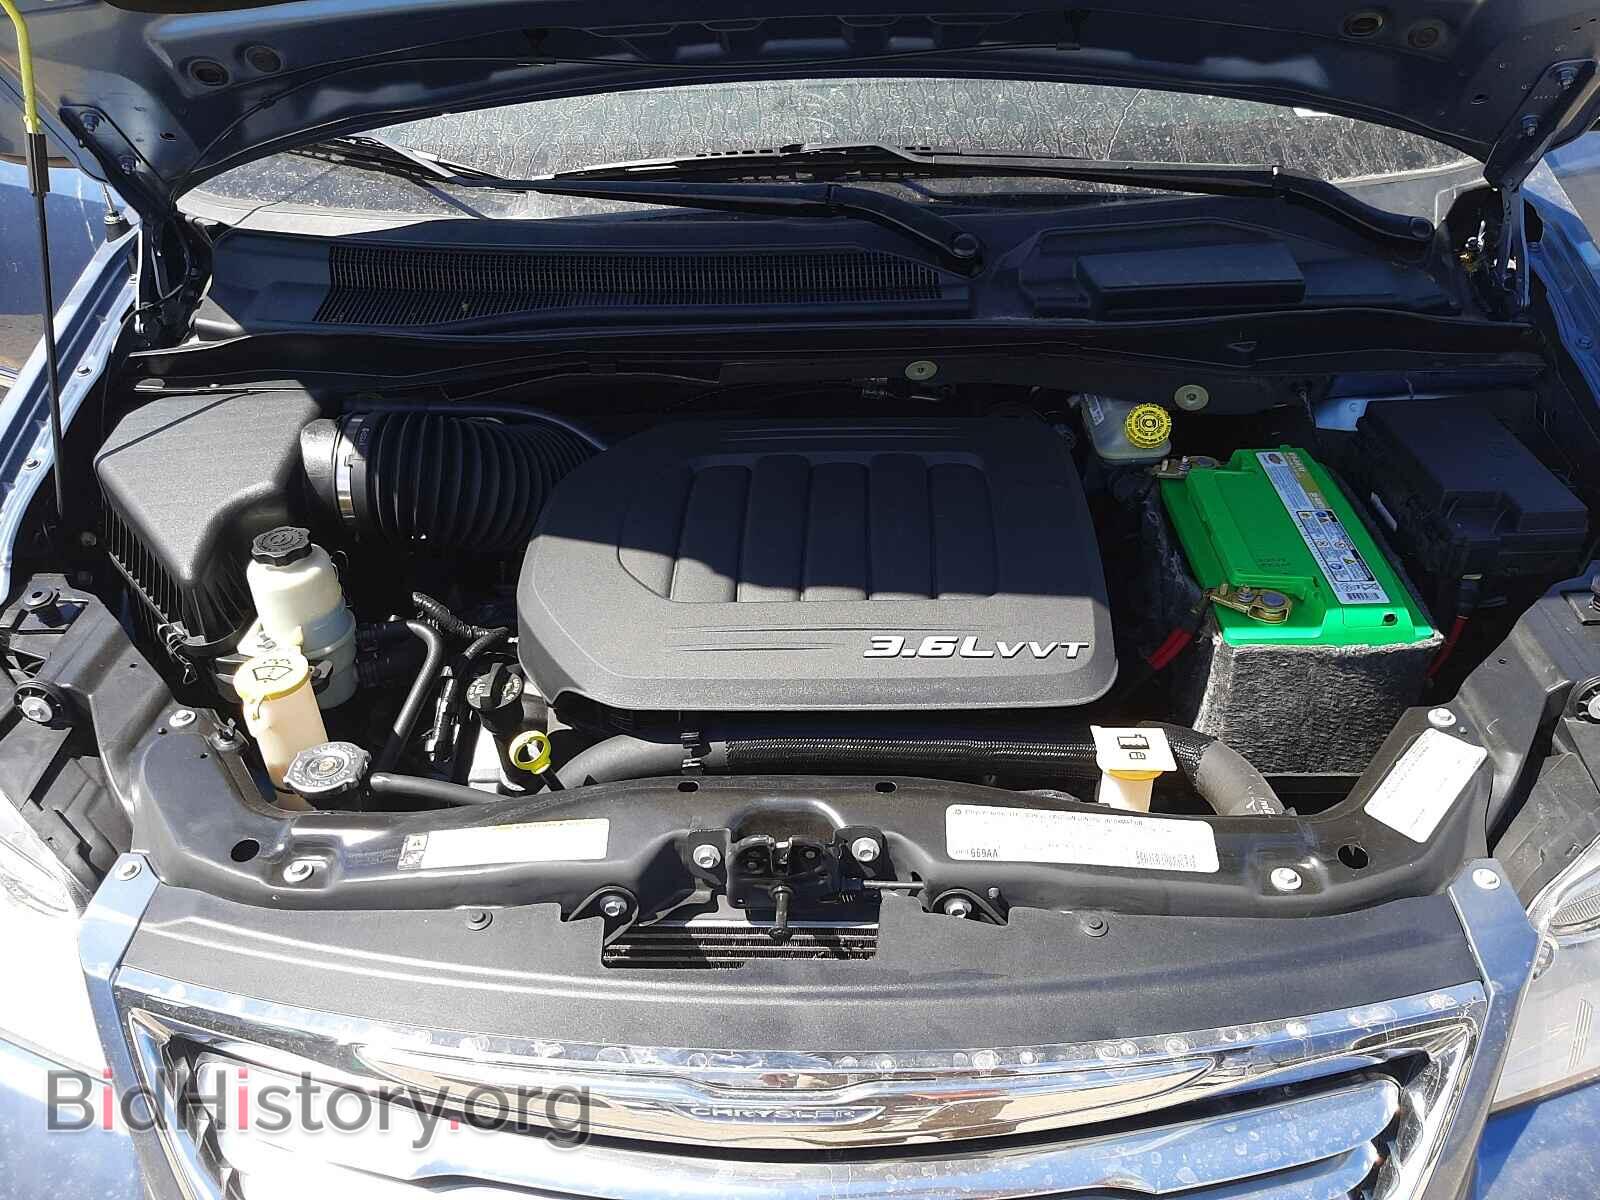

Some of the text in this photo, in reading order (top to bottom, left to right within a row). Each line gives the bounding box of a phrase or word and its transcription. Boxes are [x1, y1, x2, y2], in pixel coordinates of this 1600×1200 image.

[864, 635, 1090, 660] 3.6L VVT
[688, 1105, 856, 1119] CHRYSLER
